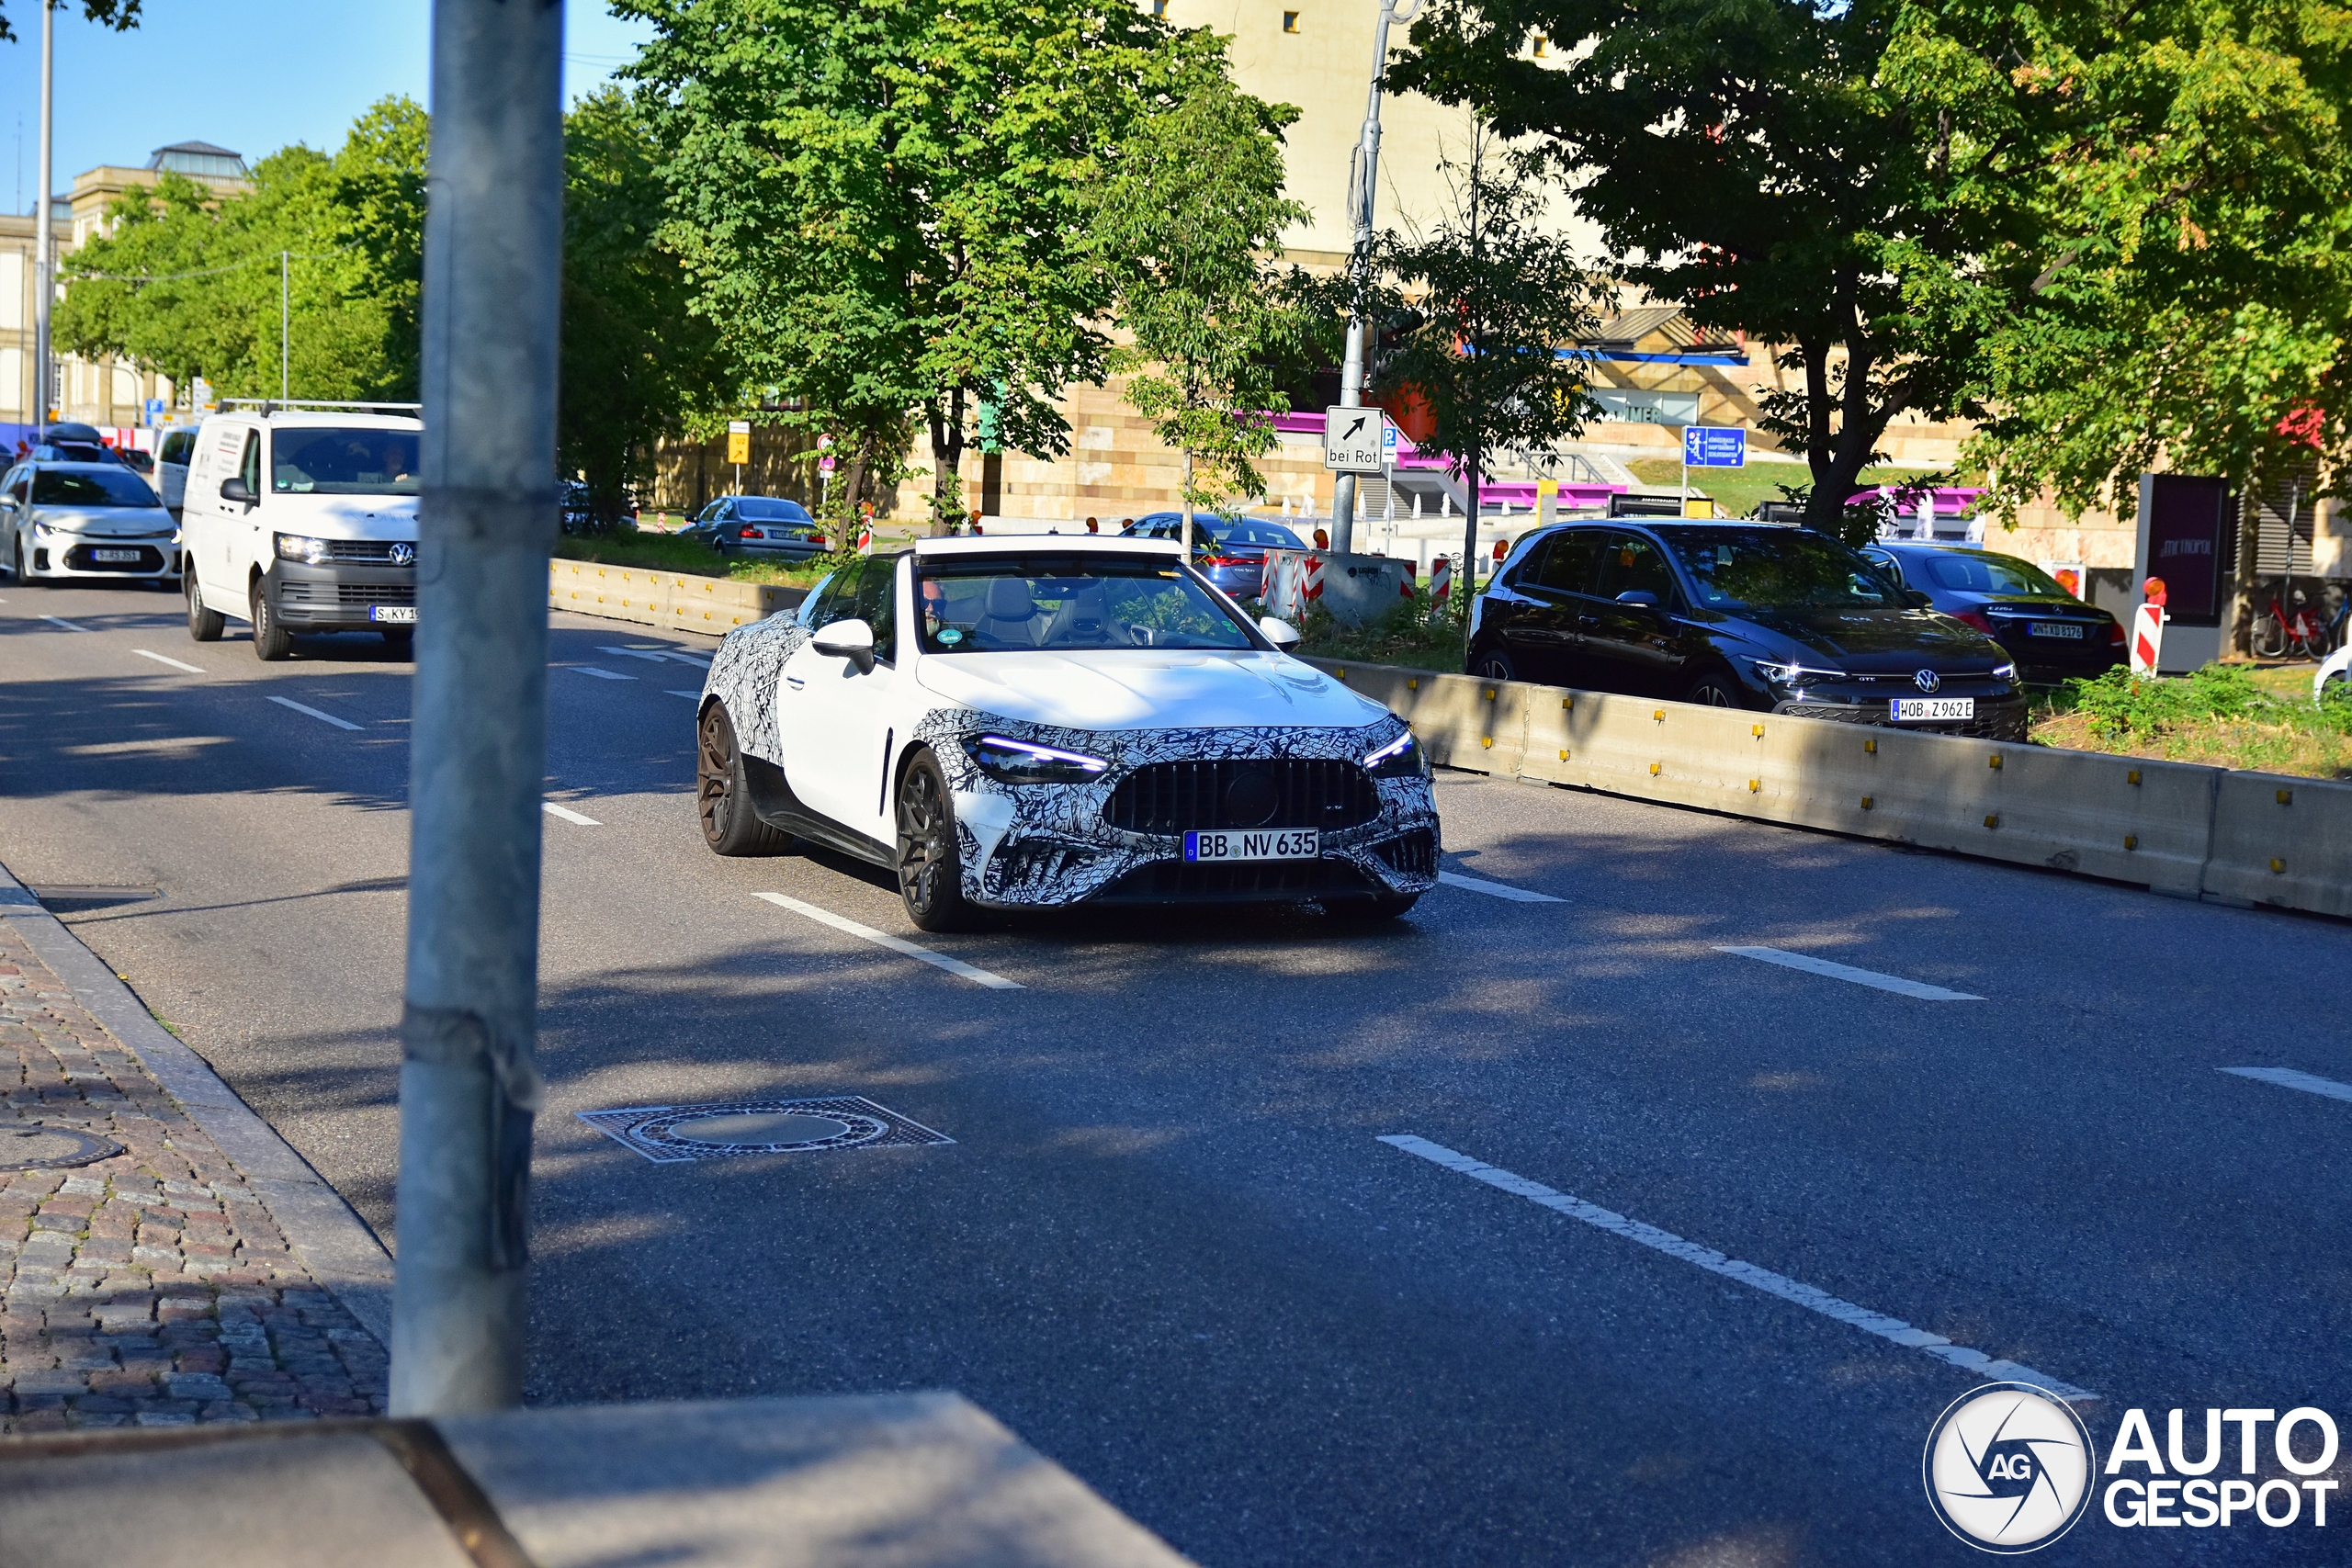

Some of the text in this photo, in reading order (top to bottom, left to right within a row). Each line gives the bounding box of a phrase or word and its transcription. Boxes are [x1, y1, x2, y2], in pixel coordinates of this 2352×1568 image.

[1329, 448, 1377, 463] bei Rot
[378, 608, 384, 619] S
[391, 608, 406, 619] KY
[2032, 624, 2044, 635] WN
[2062, 626, 2082, 637] 8176
[1901, 702, 1924, 716] WOB
[1932, 702, 1939, 716] Z
[1199, 834, 1228, 858] BB
[1243, 833, 1272, 856] NV
[1276, 832, 1317, 856] 635
